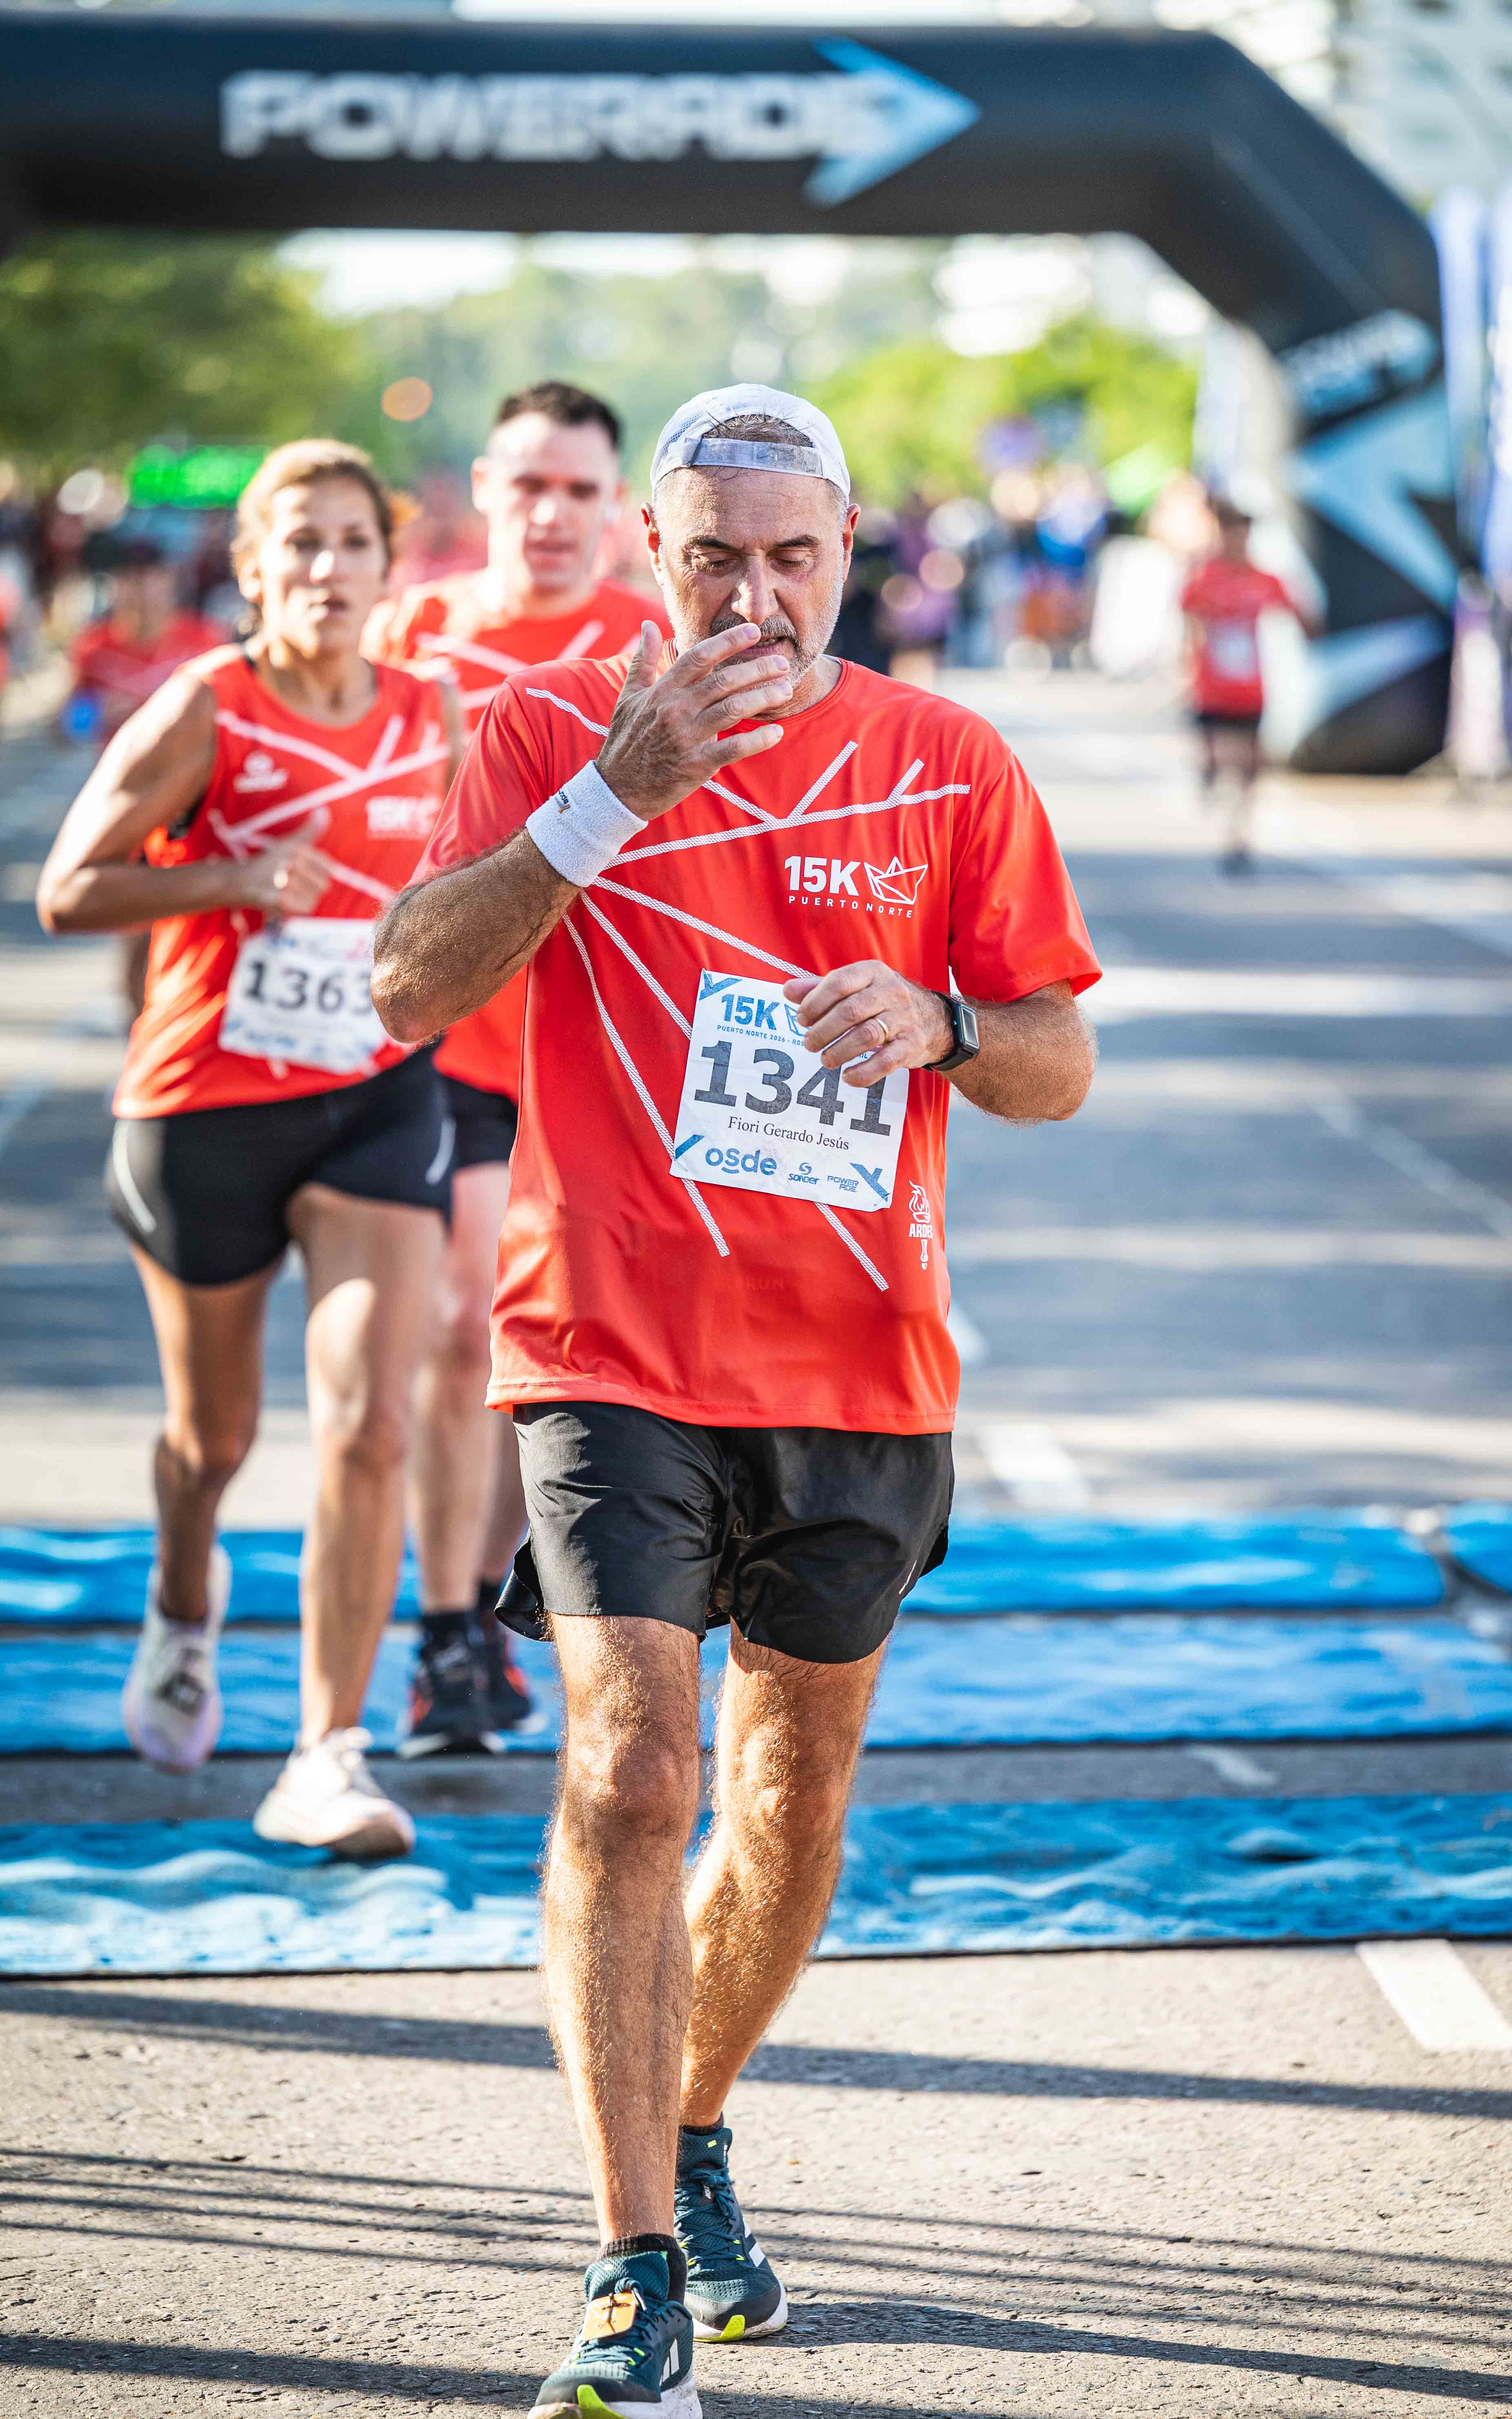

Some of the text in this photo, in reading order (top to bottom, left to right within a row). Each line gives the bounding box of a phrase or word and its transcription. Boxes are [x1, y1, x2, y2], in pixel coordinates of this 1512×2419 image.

[784, 855, 861, 897] 15K
[788, 895, 913, 918] PUERTO NORTE
[243, 959, 374, 1017] 1363
[721, 993, 780, 1031] 15K
[717, 1025, 744, 1034] PUERTO
[746, 1030, 768, 1039] NORTE
[694, 1040, 891, 1136] 1341
[728, 1116, 849, 1150] Fiori Gerardo Jesús
[705, 1148, 777, 1176] osde
[827, 1175, 859, 1186] POWER
